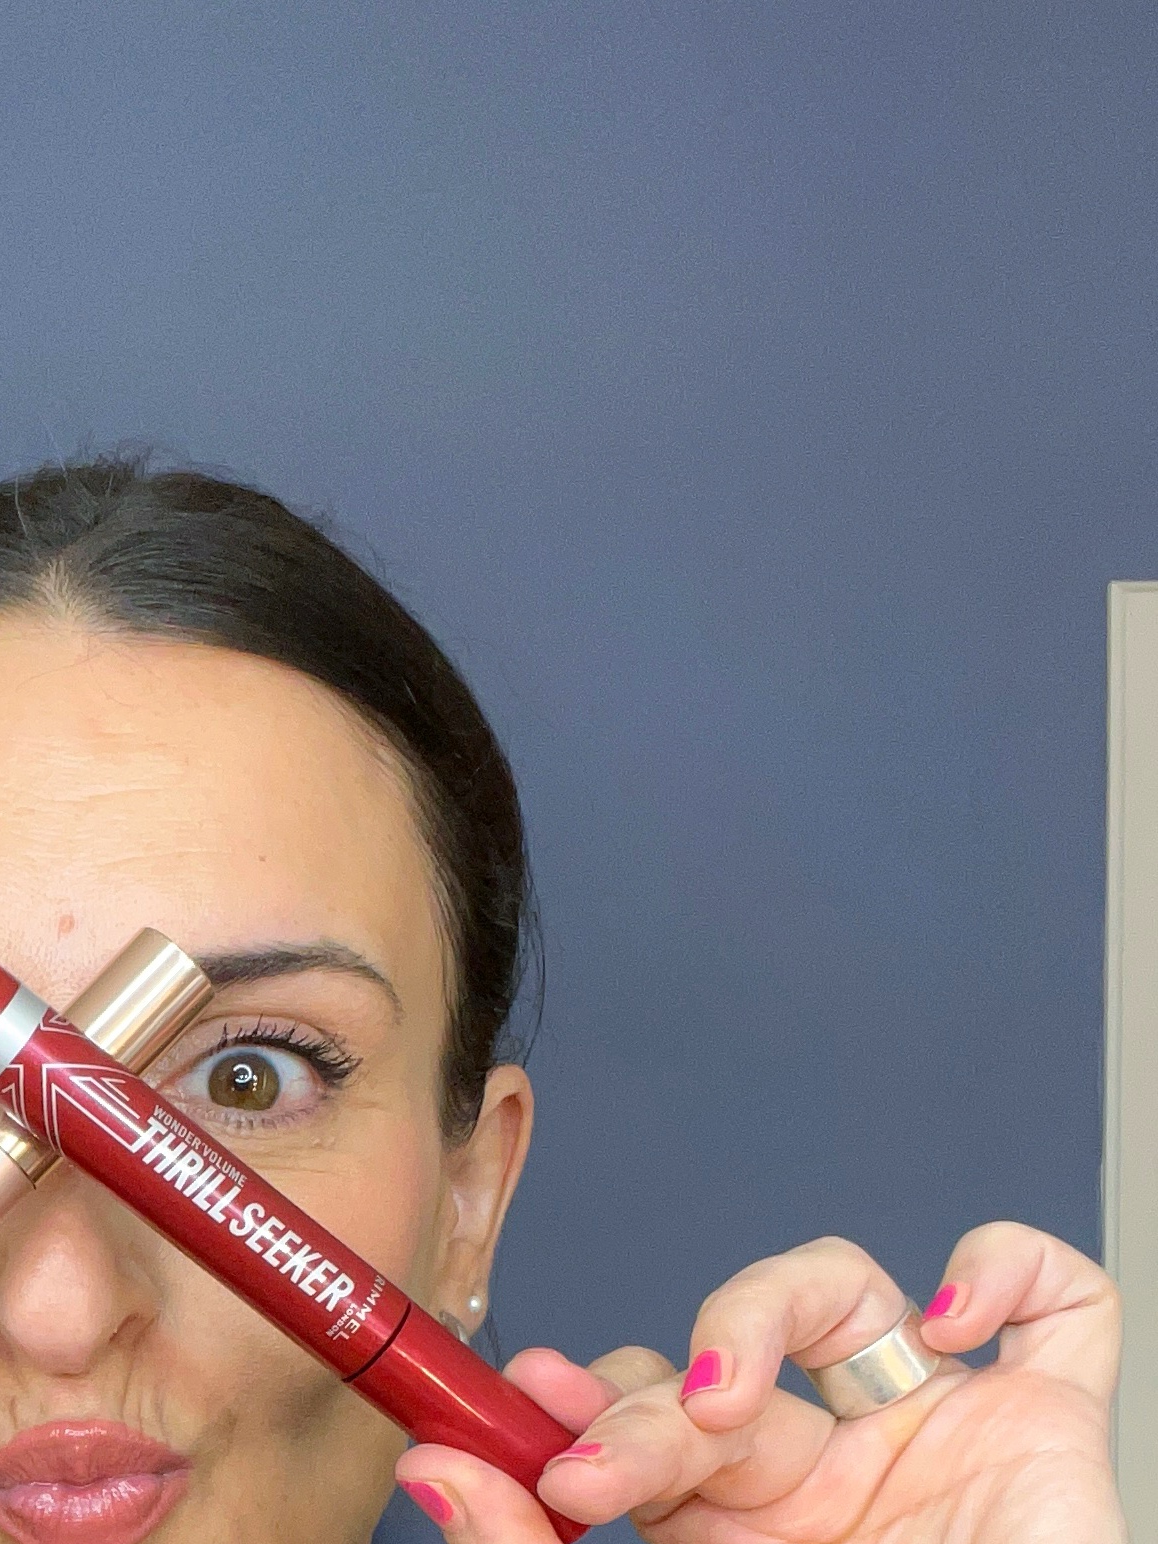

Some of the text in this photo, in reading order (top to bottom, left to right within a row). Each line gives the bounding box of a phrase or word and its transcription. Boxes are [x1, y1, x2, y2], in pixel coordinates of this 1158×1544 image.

[133, 1116, 355, 1312] THRILL SEEKER
[325, 1303, 358, 1337] LONDON
[332, 1275, 385, 1341] RIMMEL
